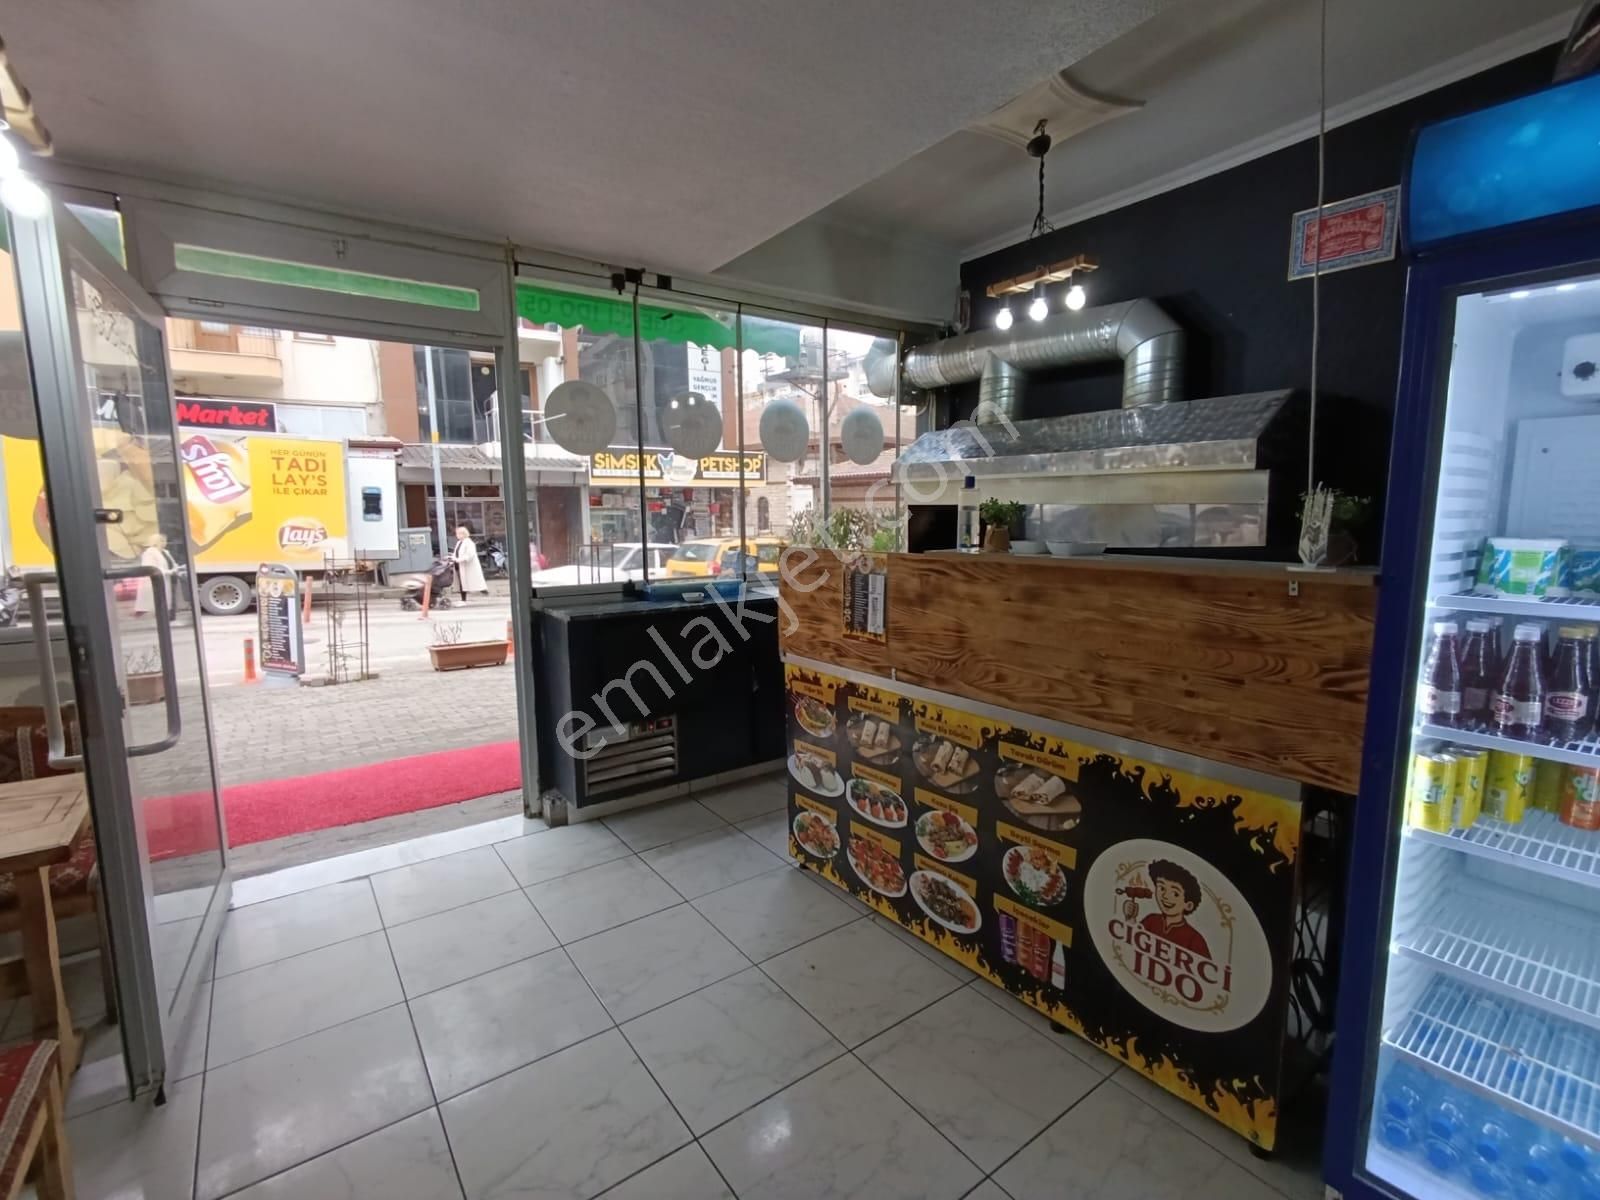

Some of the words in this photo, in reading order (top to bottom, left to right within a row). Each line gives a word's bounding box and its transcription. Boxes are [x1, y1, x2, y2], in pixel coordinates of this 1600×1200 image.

[176, 402, 269, 426] Market
[271, 457, 327, 473] TADI
[271, 474, 327, 486] LAY'S
[1133, 949, 1204, 1003] IDO
